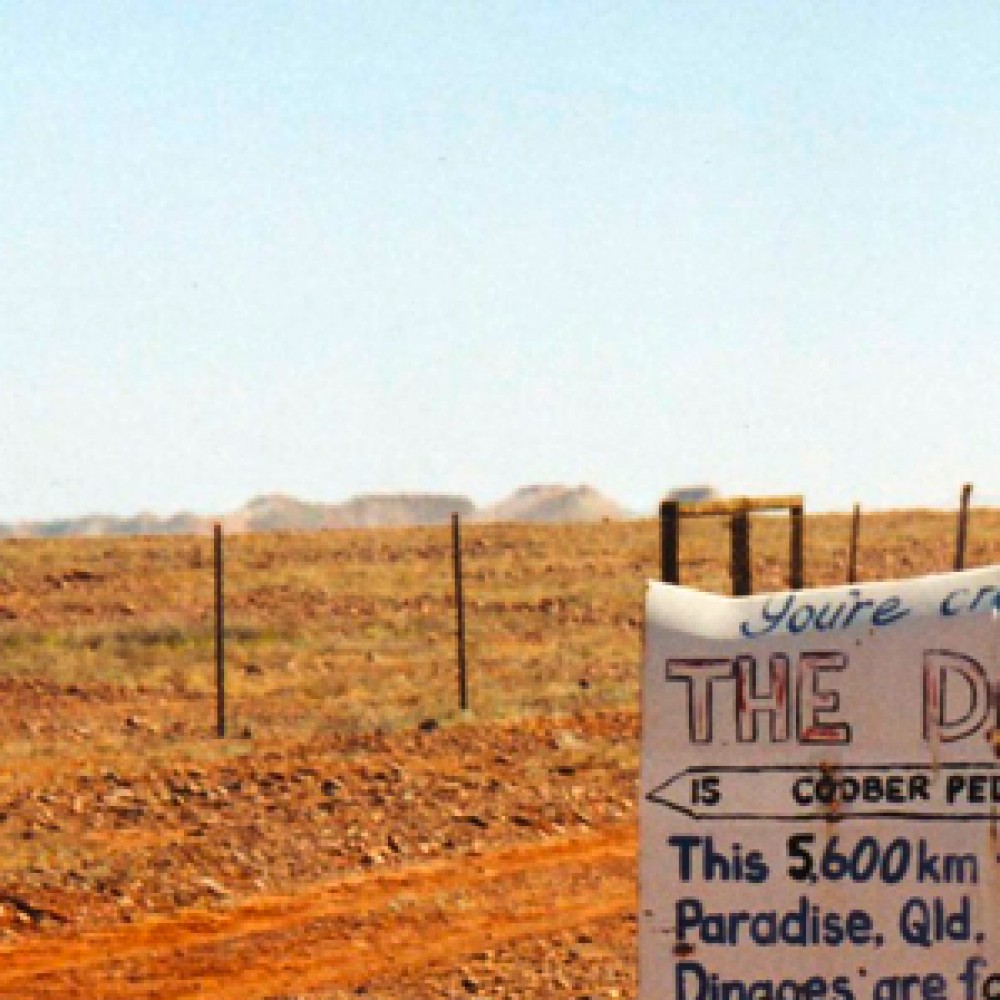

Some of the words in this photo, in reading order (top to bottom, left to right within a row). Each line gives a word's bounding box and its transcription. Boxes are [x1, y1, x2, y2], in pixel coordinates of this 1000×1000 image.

[665, 650, 850, 745] THE
[793, 774, 931, 805] COOBER
[668, 836, 769, 883] This
